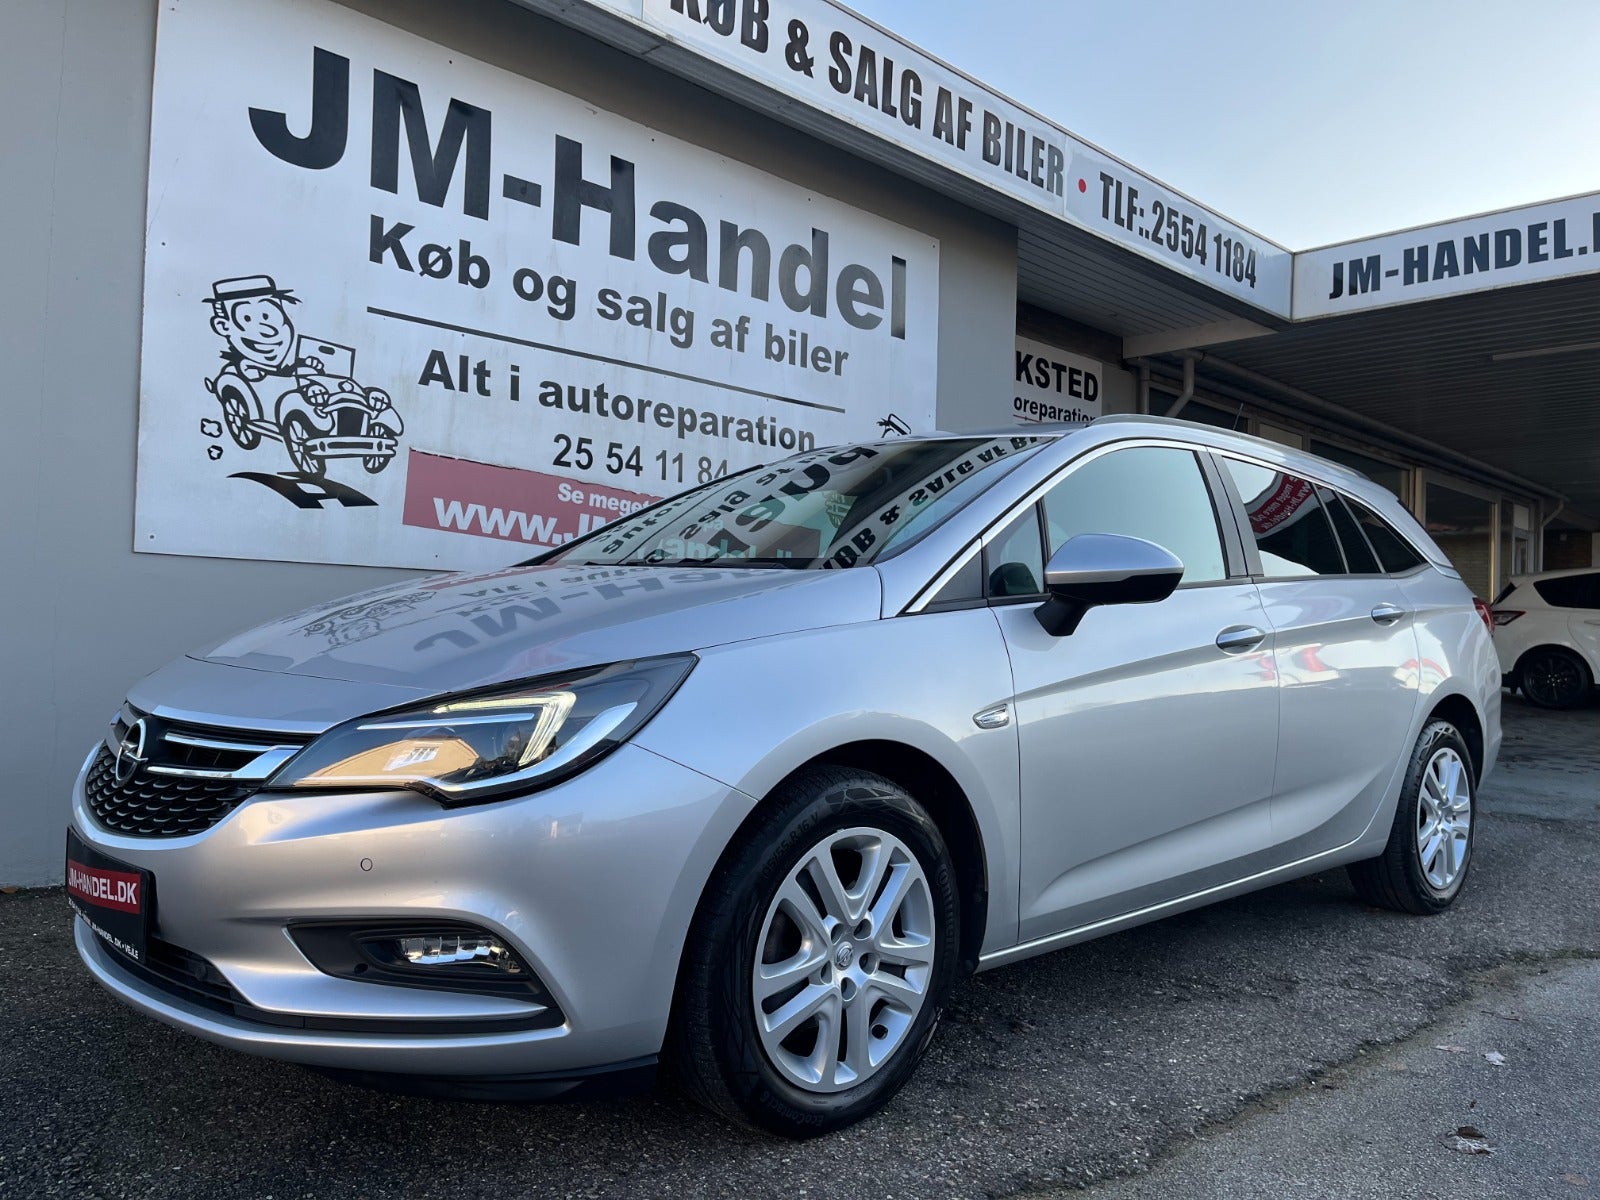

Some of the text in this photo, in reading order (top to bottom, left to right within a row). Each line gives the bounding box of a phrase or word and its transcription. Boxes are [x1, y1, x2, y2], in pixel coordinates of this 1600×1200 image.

[248, 46, 906, 341] JM-Handel
[785, 19, 814, 78] &
[829, 31, 922, 129] SALG
[933, 86, 972, 151] AF
[982, 109, 1064, 197] BILER
[1213, 233, 1256, 288] 1184
[369, 214, 848, 376] Køb og salg af biler
[1329, 212, 1600, 299] JM-HANDEL.
[418, 349, 815, 452] Alt i autoreparation
[1016, 351, 1098, 402] KSTED
[553, 434, 728, 484] 25 54 11 84
[557, 483, 584, 504] Se
[589, 493, 650, 517] meget
[69, 867, 137, 905] JM-HANDEL.DK
